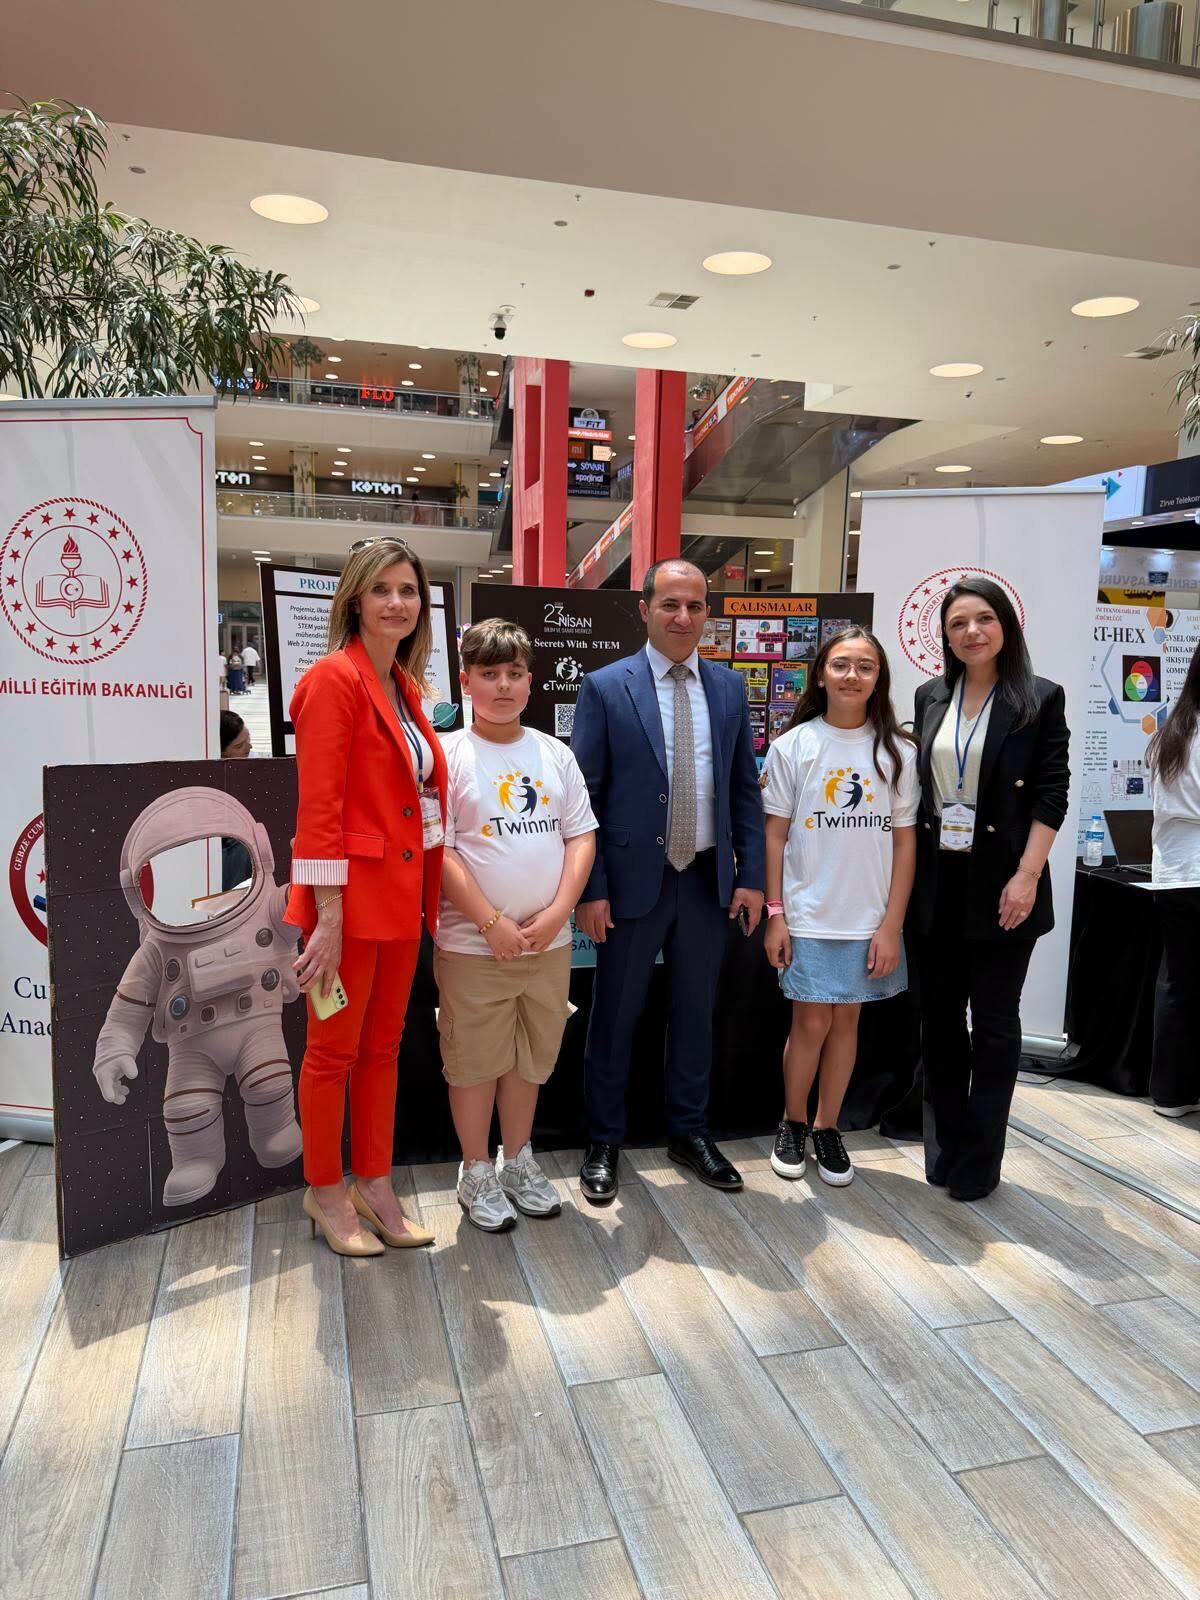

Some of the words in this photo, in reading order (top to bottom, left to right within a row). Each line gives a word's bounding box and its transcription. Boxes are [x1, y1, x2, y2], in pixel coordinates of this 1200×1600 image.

[361, 387, 394, 402] FLO
[352, 480, 402, 495] KOTON
[730, 601, 813, 613] ÇALIŞMALAR
[558, 614, 592, 628] NİSAN
[534, 638, 565, 649] Secrets
[566, 640, 588, 649] With
[592, 641, 620, 650] STEM
[41, 678, 97, 697] EĞİTİM
[101, 681, 193, 699] BAKANLIĞI
[804, 811, 892, 832] eTwinning
[14, 838, 30, 871] GEBZE
